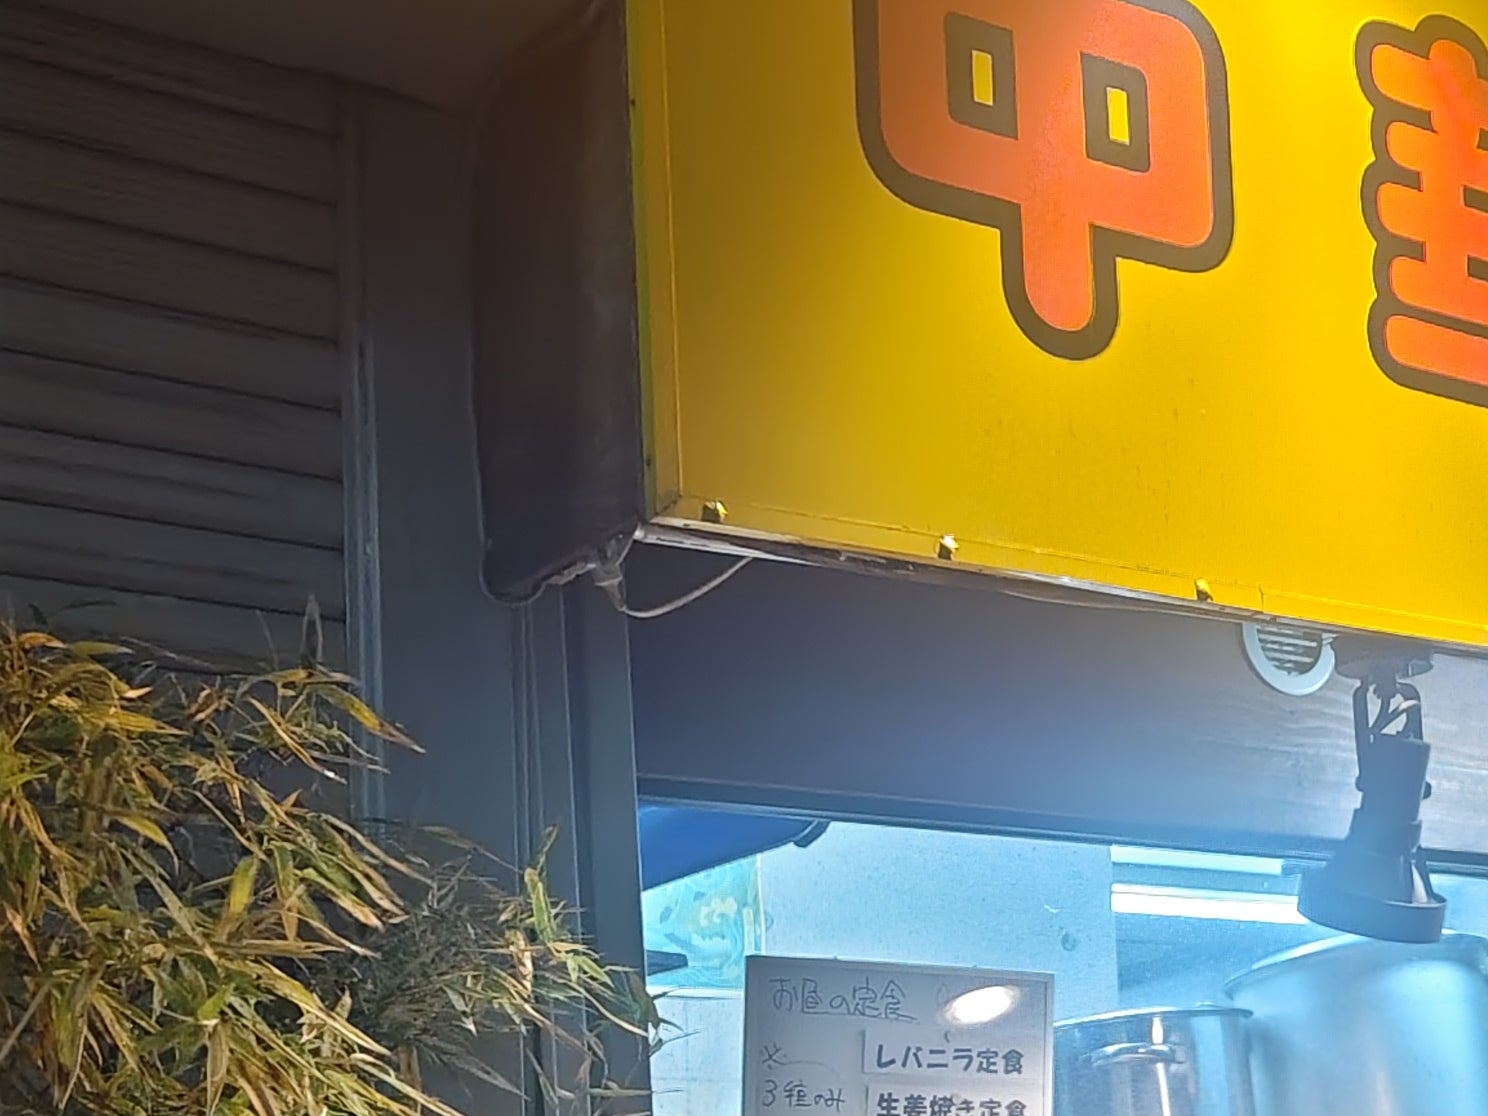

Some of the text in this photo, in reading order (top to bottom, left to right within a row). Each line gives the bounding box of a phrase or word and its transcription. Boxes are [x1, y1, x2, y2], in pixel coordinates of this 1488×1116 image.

[875, 1043, 1025, 1075] レバニラ定食
